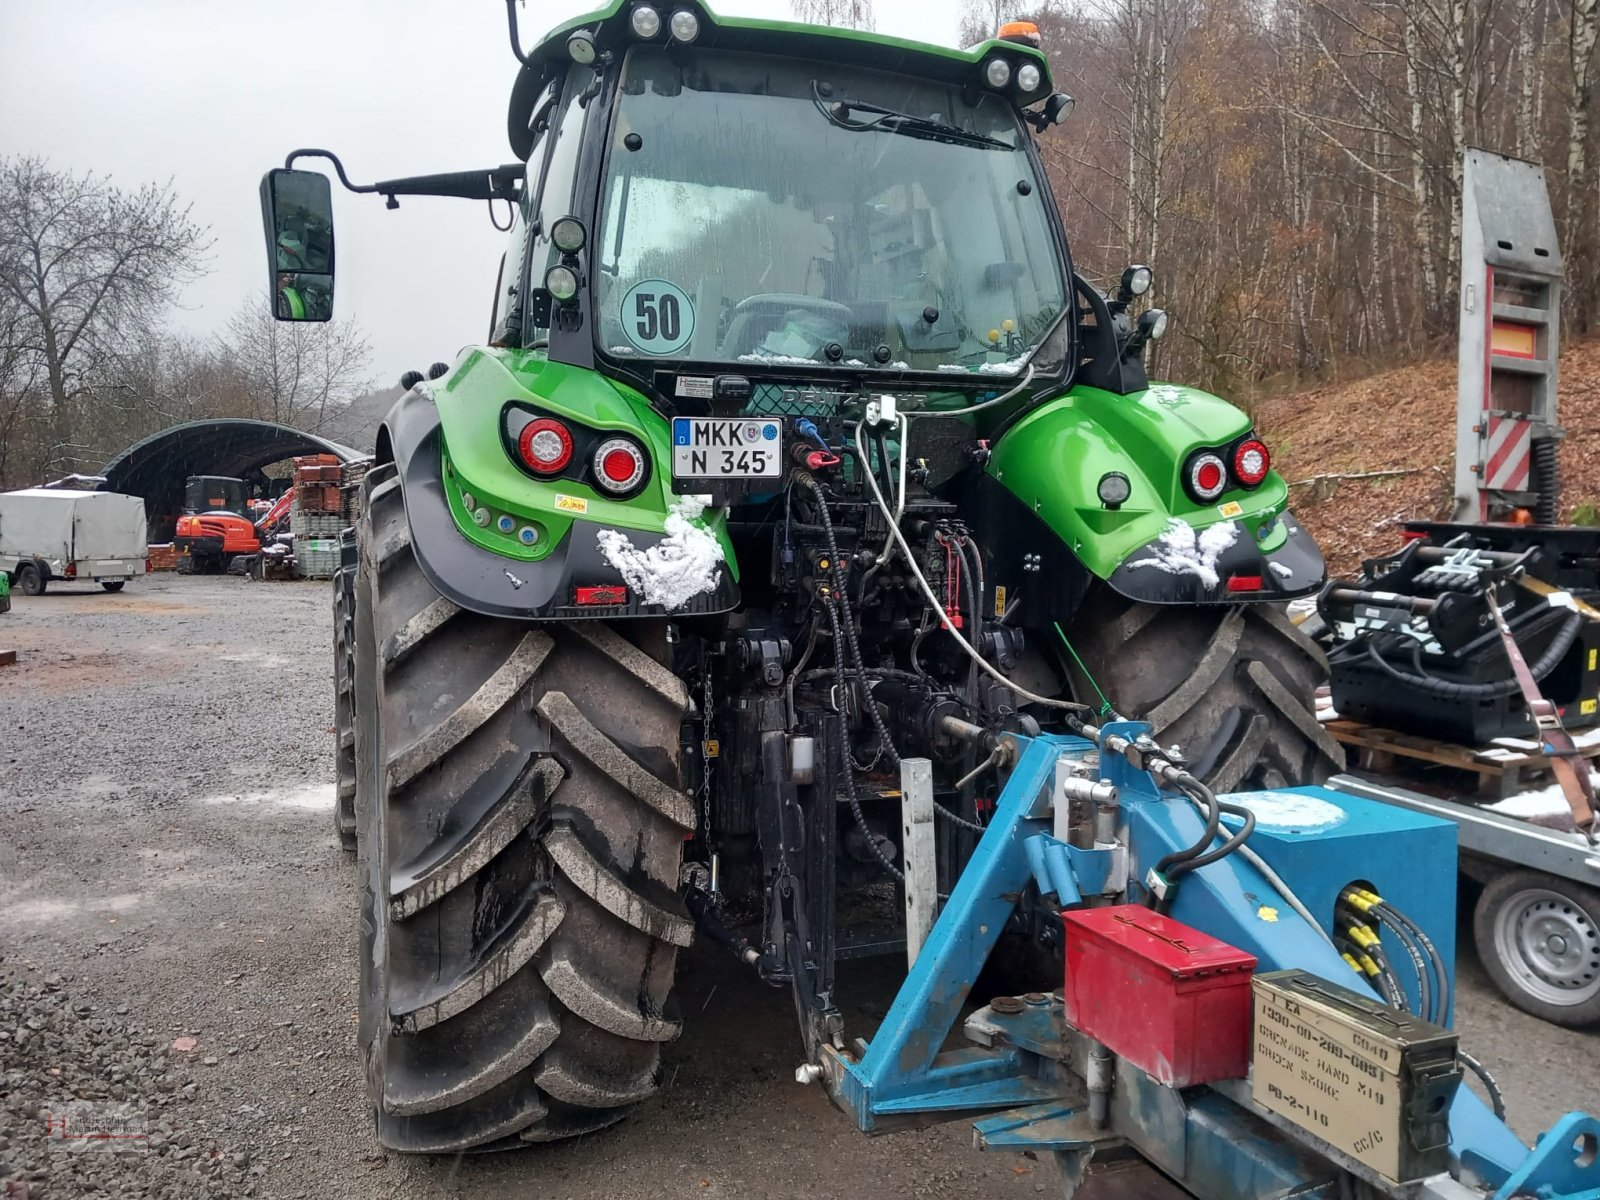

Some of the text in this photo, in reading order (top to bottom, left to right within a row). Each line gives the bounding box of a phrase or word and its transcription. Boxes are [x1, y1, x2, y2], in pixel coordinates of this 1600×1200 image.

[635, 293, 681, 341] 50
[679, 435, 686, 444] D
[694, 422, 743, 446] MKK
[692, 450, 766, 474] N 345
[1284, 999, 1301, 1016] EA
[1259, 1024, 1310, 1062] GRENADE
[1317, 1058, 1350, 1085] HAND
[1258, 1043, 1340, 1101] GREEN SMOKE
